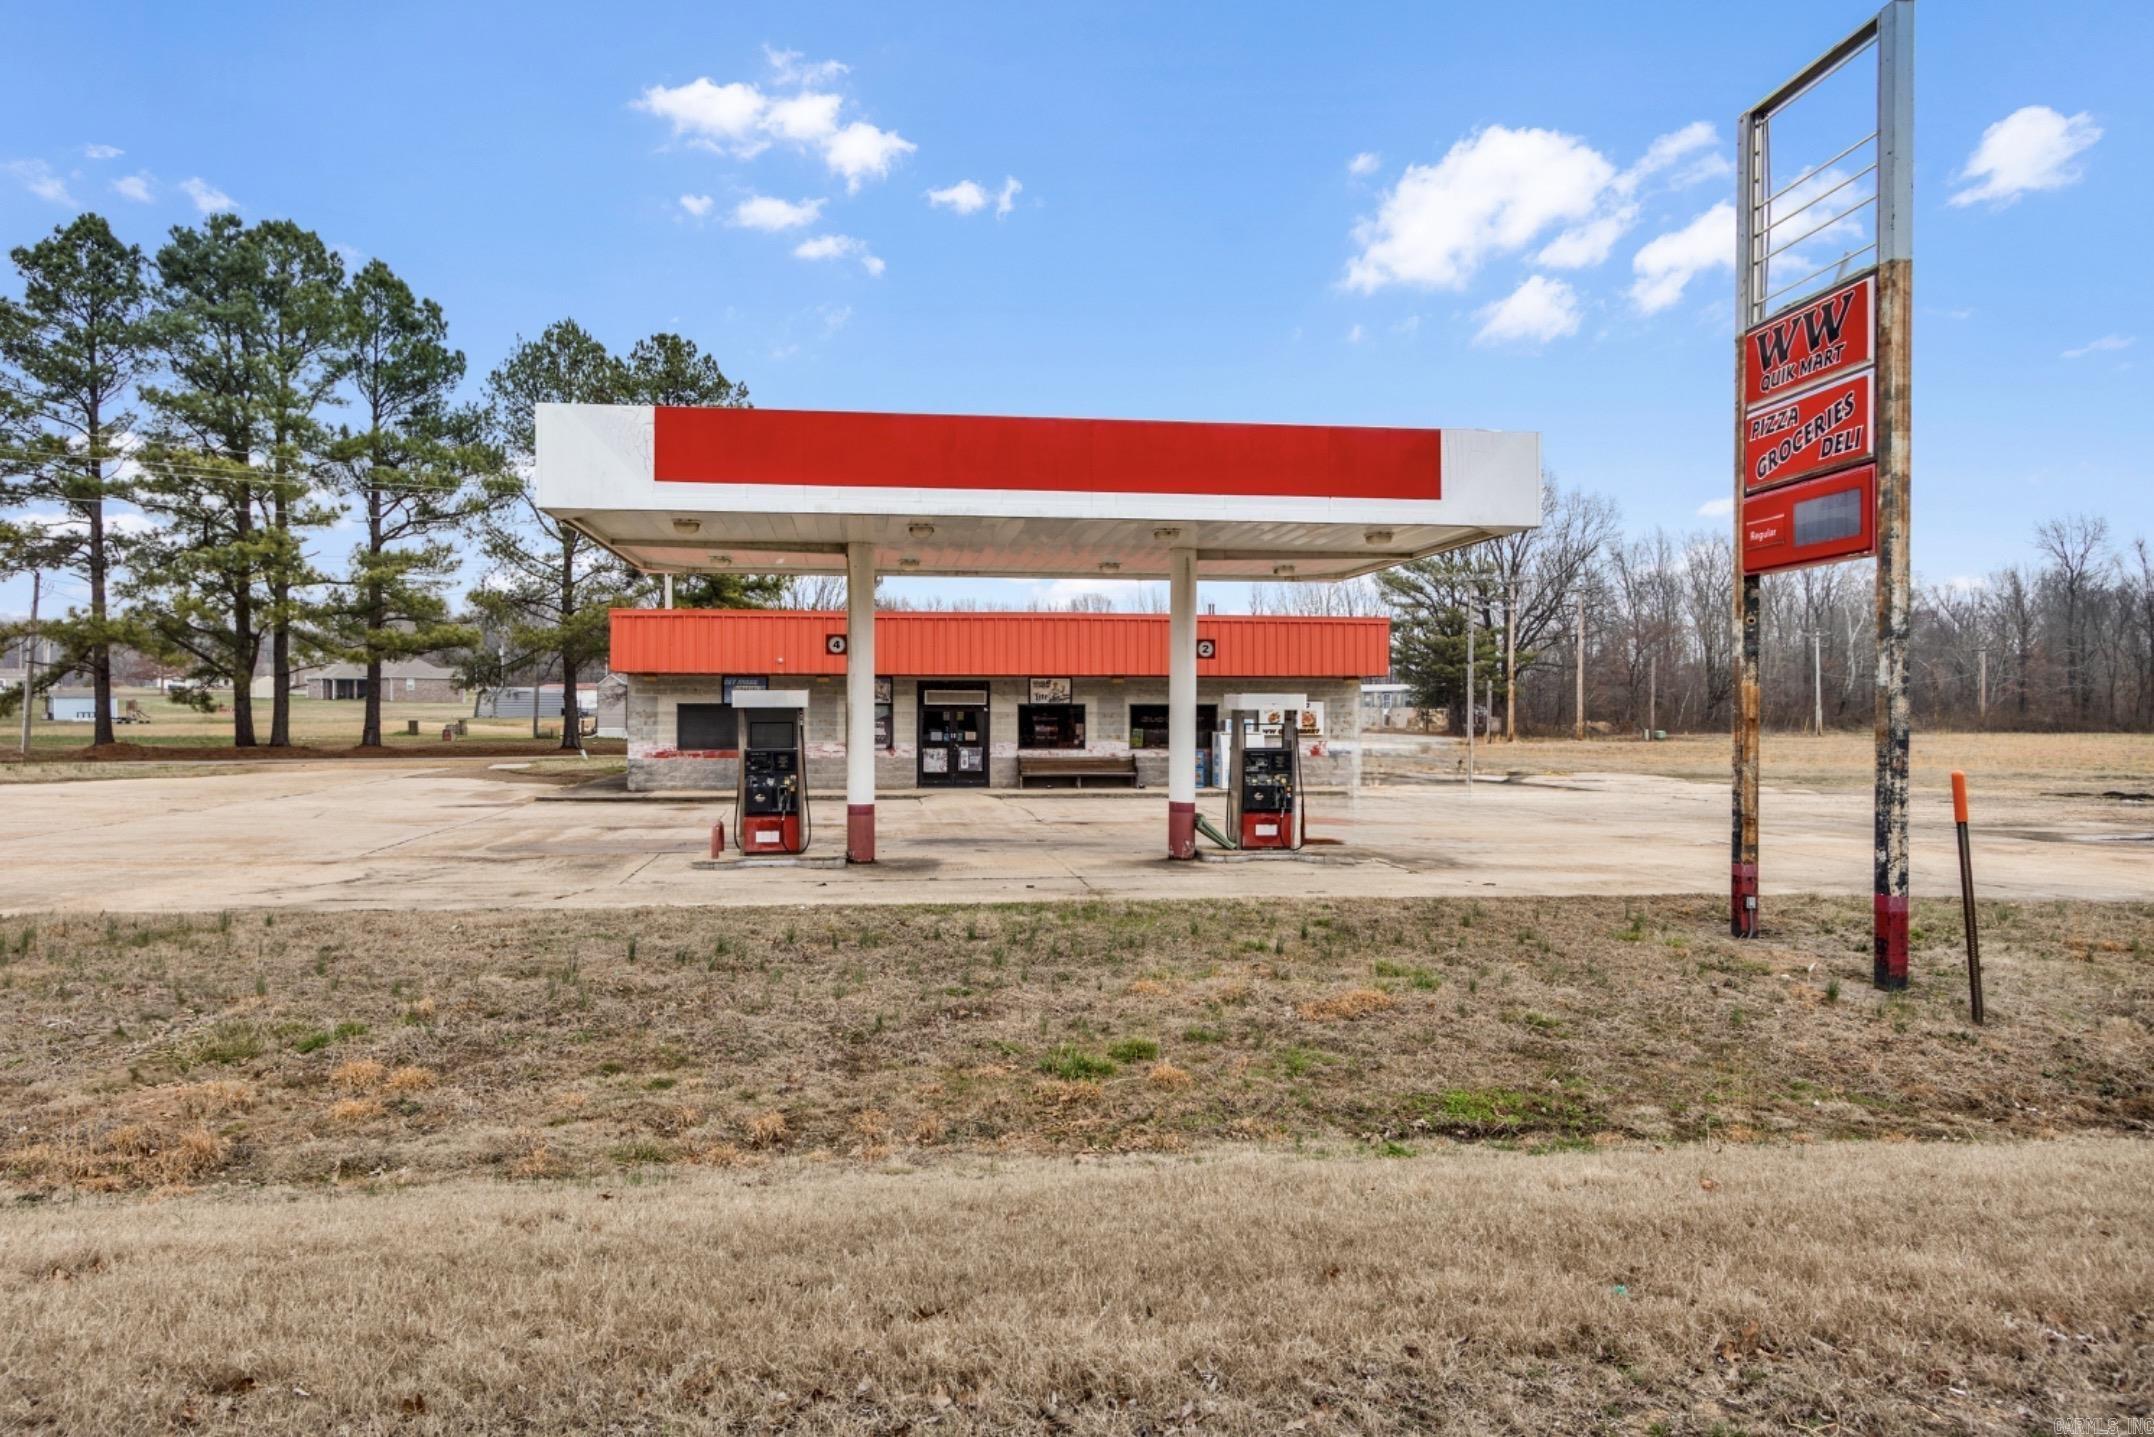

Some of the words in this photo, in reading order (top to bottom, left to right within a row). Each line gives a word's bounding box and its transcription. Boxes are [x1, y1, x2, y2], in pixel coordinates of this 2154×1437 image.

[1756, 290, 1855, 373] WW
[1760, 362, 1797, 393] QUIK
[1798, 342, 1846, 378] MART
[1749, 405, 1799, 441] PIZZA
[1756, 390, 1855, 479] GROCERIES
[1818, 425, 1864, 460] DELI
[1750, 528, 1777, 542] Regular
[833, 640, 841, 649] 4
[1202, 644, 1209, 654] 2
